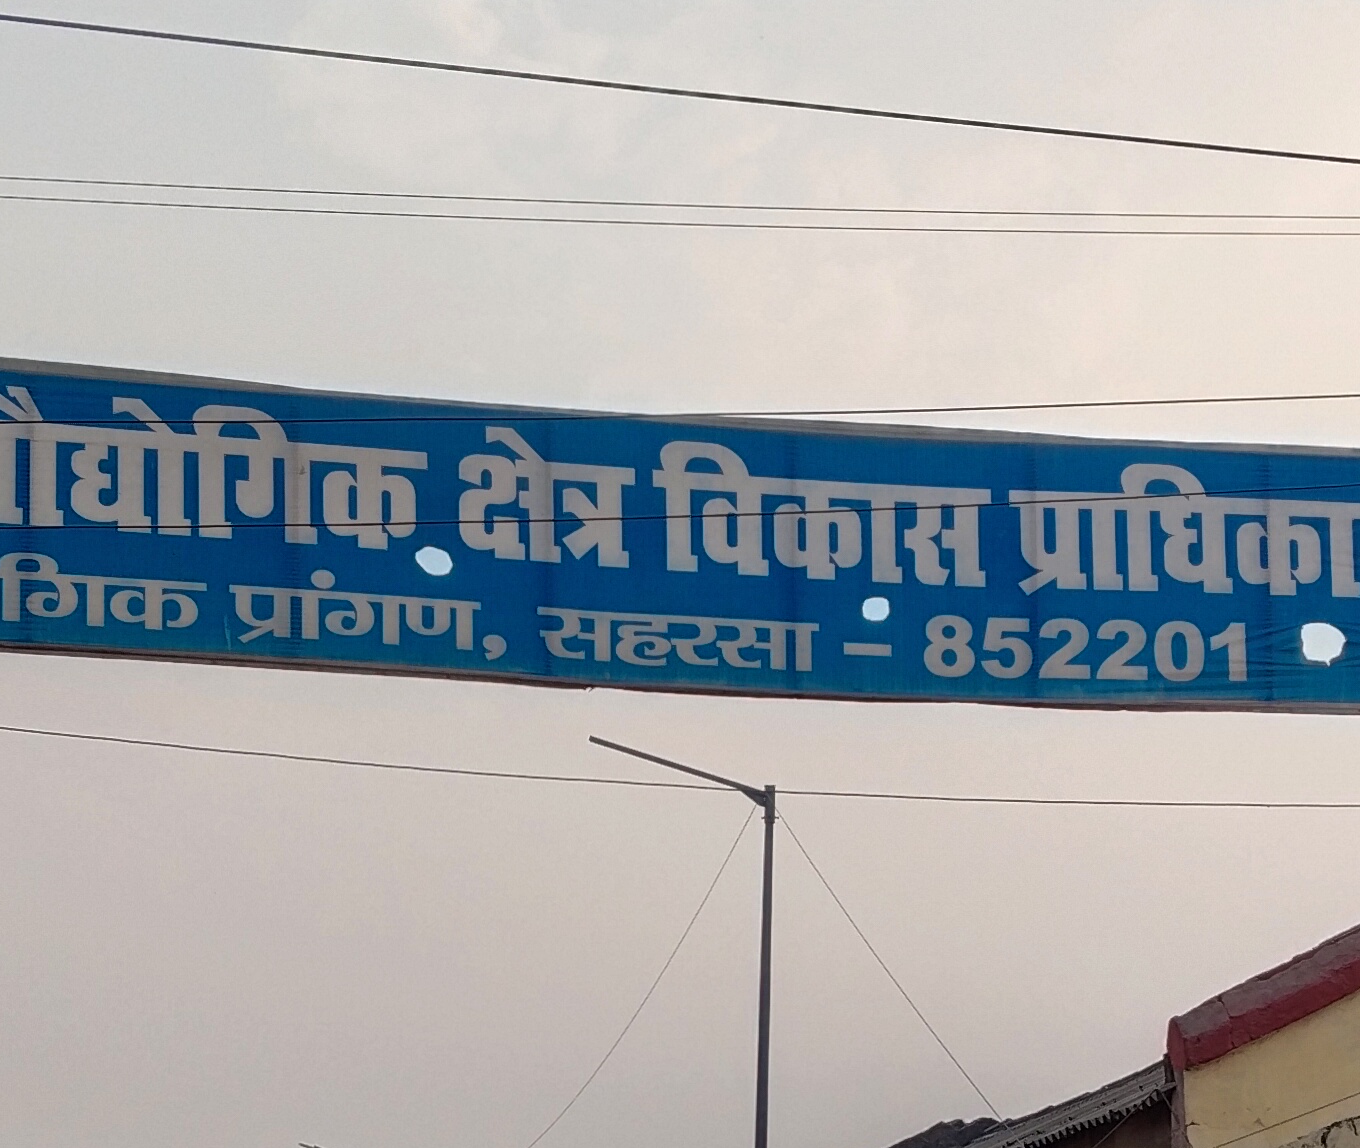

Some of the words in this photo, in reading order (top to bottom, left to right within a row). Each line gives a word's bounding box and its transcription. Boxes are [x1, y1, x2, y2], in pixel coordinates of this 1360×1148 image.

[458, 426, 635, 569] क्षेत्र
[652, 440, 992, 589] विकास
[229, 569, 507, 660] प्रांगण,
[538, 606, 819, 672] सहरसा
[923, 614, 1249, 683] 852201
